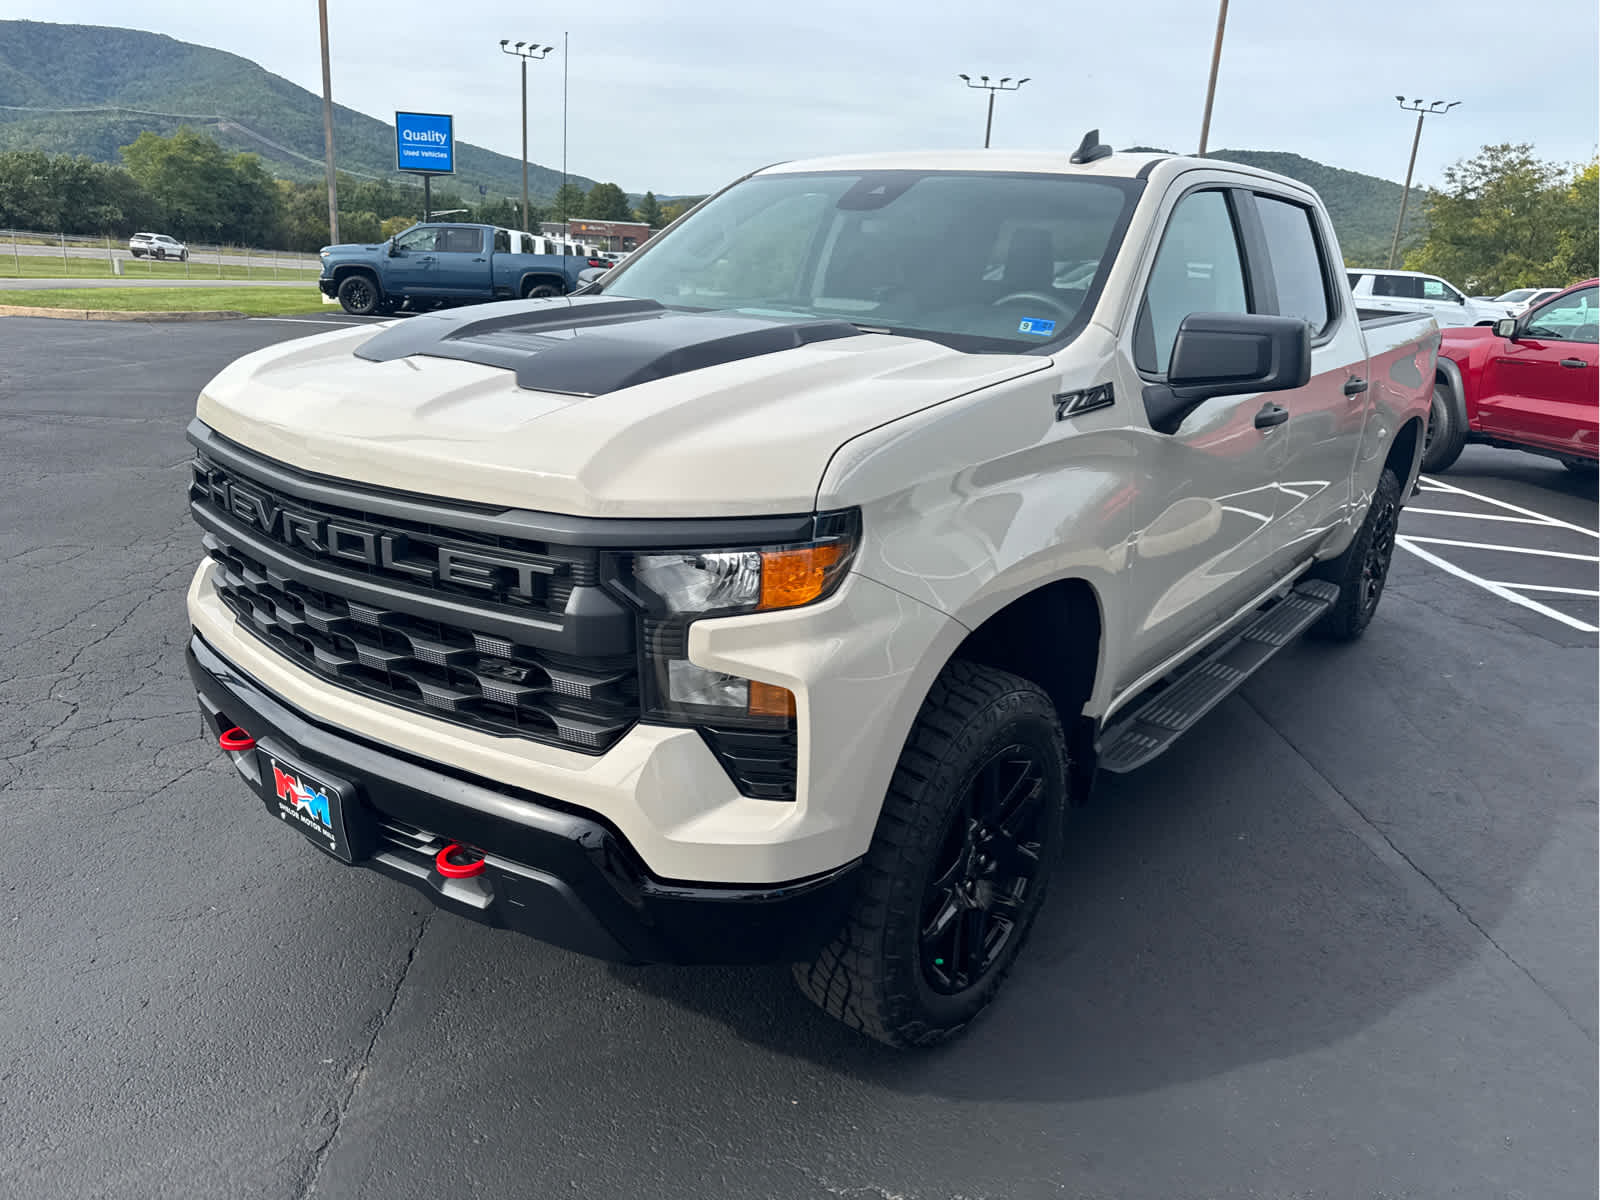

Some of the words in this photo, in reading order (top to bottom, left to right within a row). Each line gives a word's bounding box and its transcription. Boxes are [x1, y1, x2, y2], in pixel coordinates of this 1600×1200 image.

[403, 129, 447, 145] Quality
[421, 150, 448, 158] Vehicles
[191, 457, 566, 598] CHEVROLET
[300, 815, 322, 833] MOTOR
